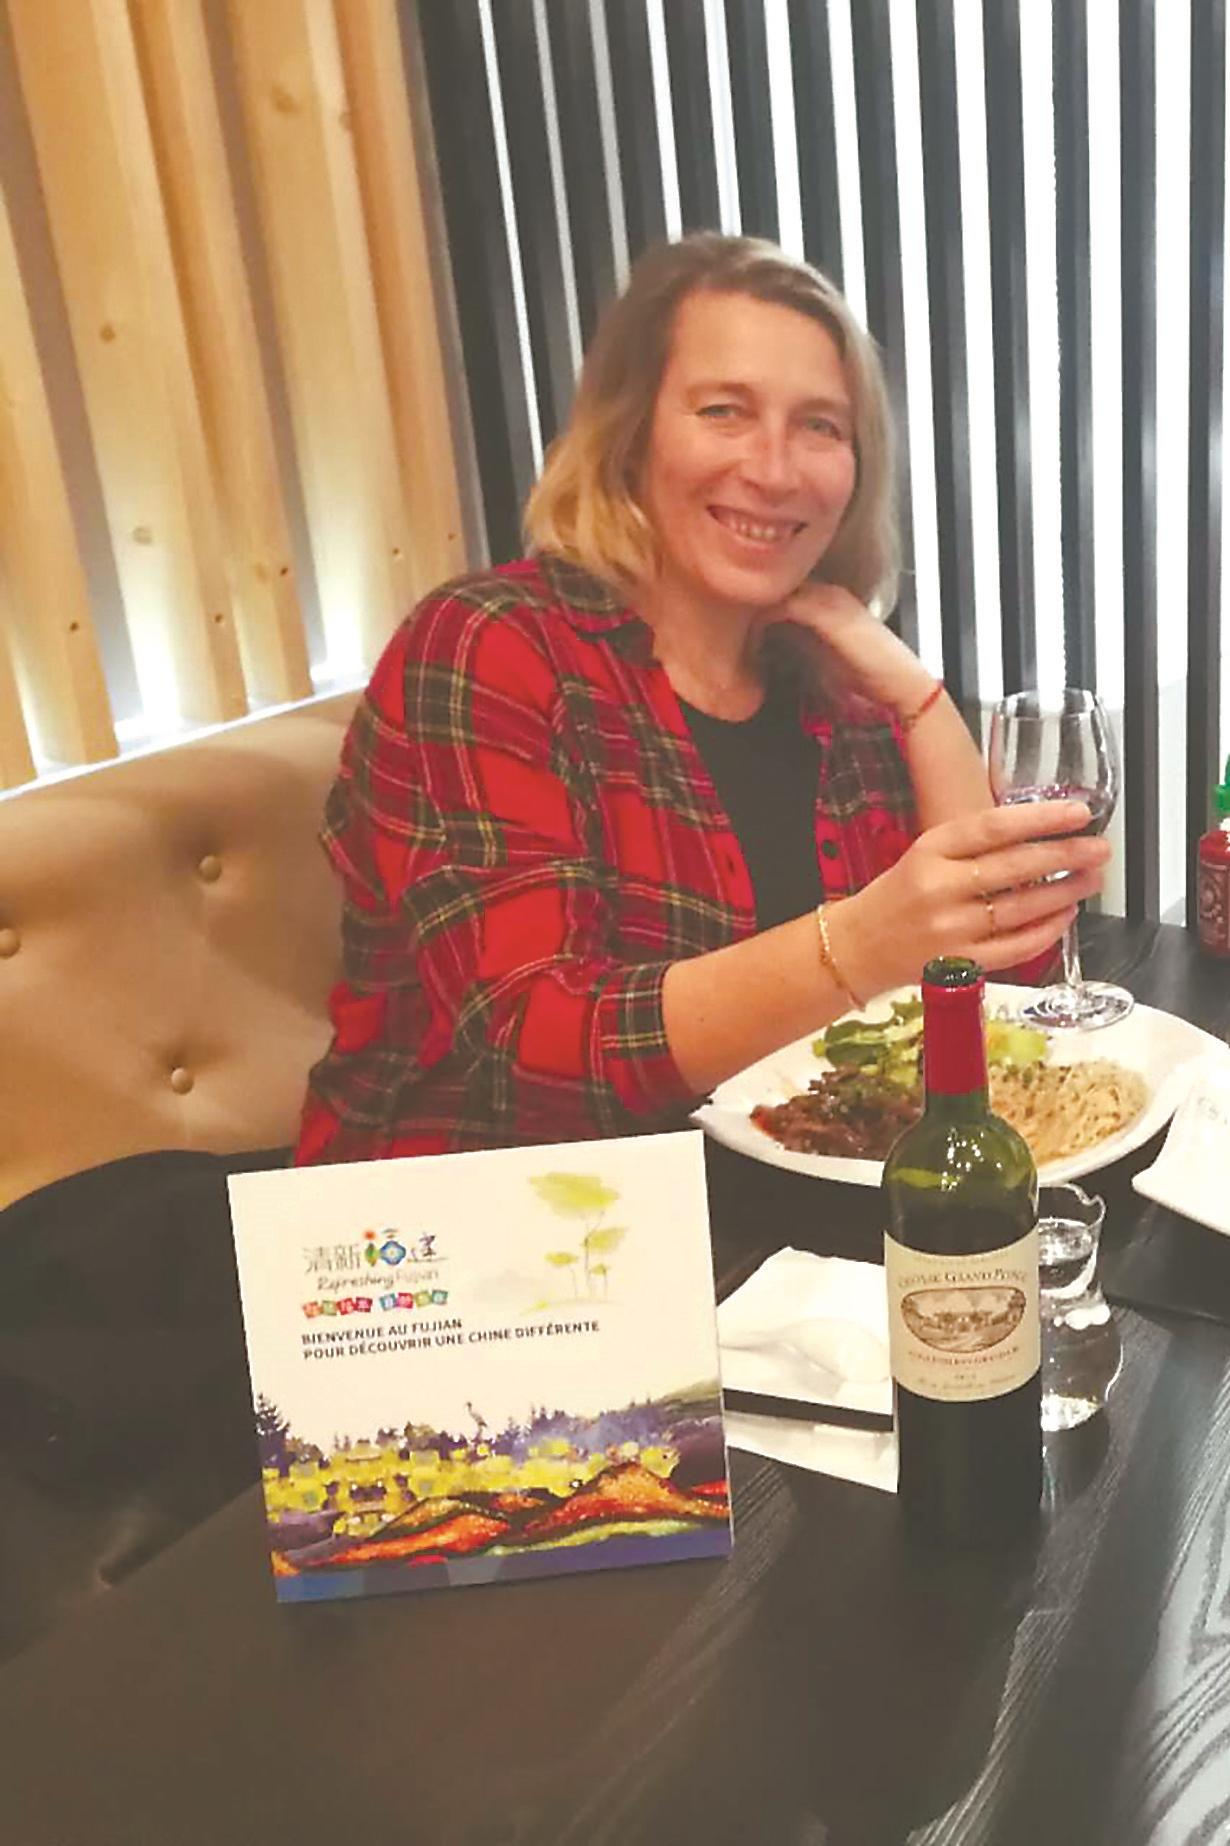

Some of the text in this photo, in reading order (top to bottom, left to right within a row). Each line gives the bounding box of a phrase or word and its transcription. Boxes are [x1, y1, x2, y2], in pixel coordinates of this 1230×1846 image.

[302, 1318, 463, 1345] BIENVENUE AU FUJIAN
[303, 1319, 601, 1360] POUR DÉCOUVRIR UNE CHINE DIFFÉRENTE
